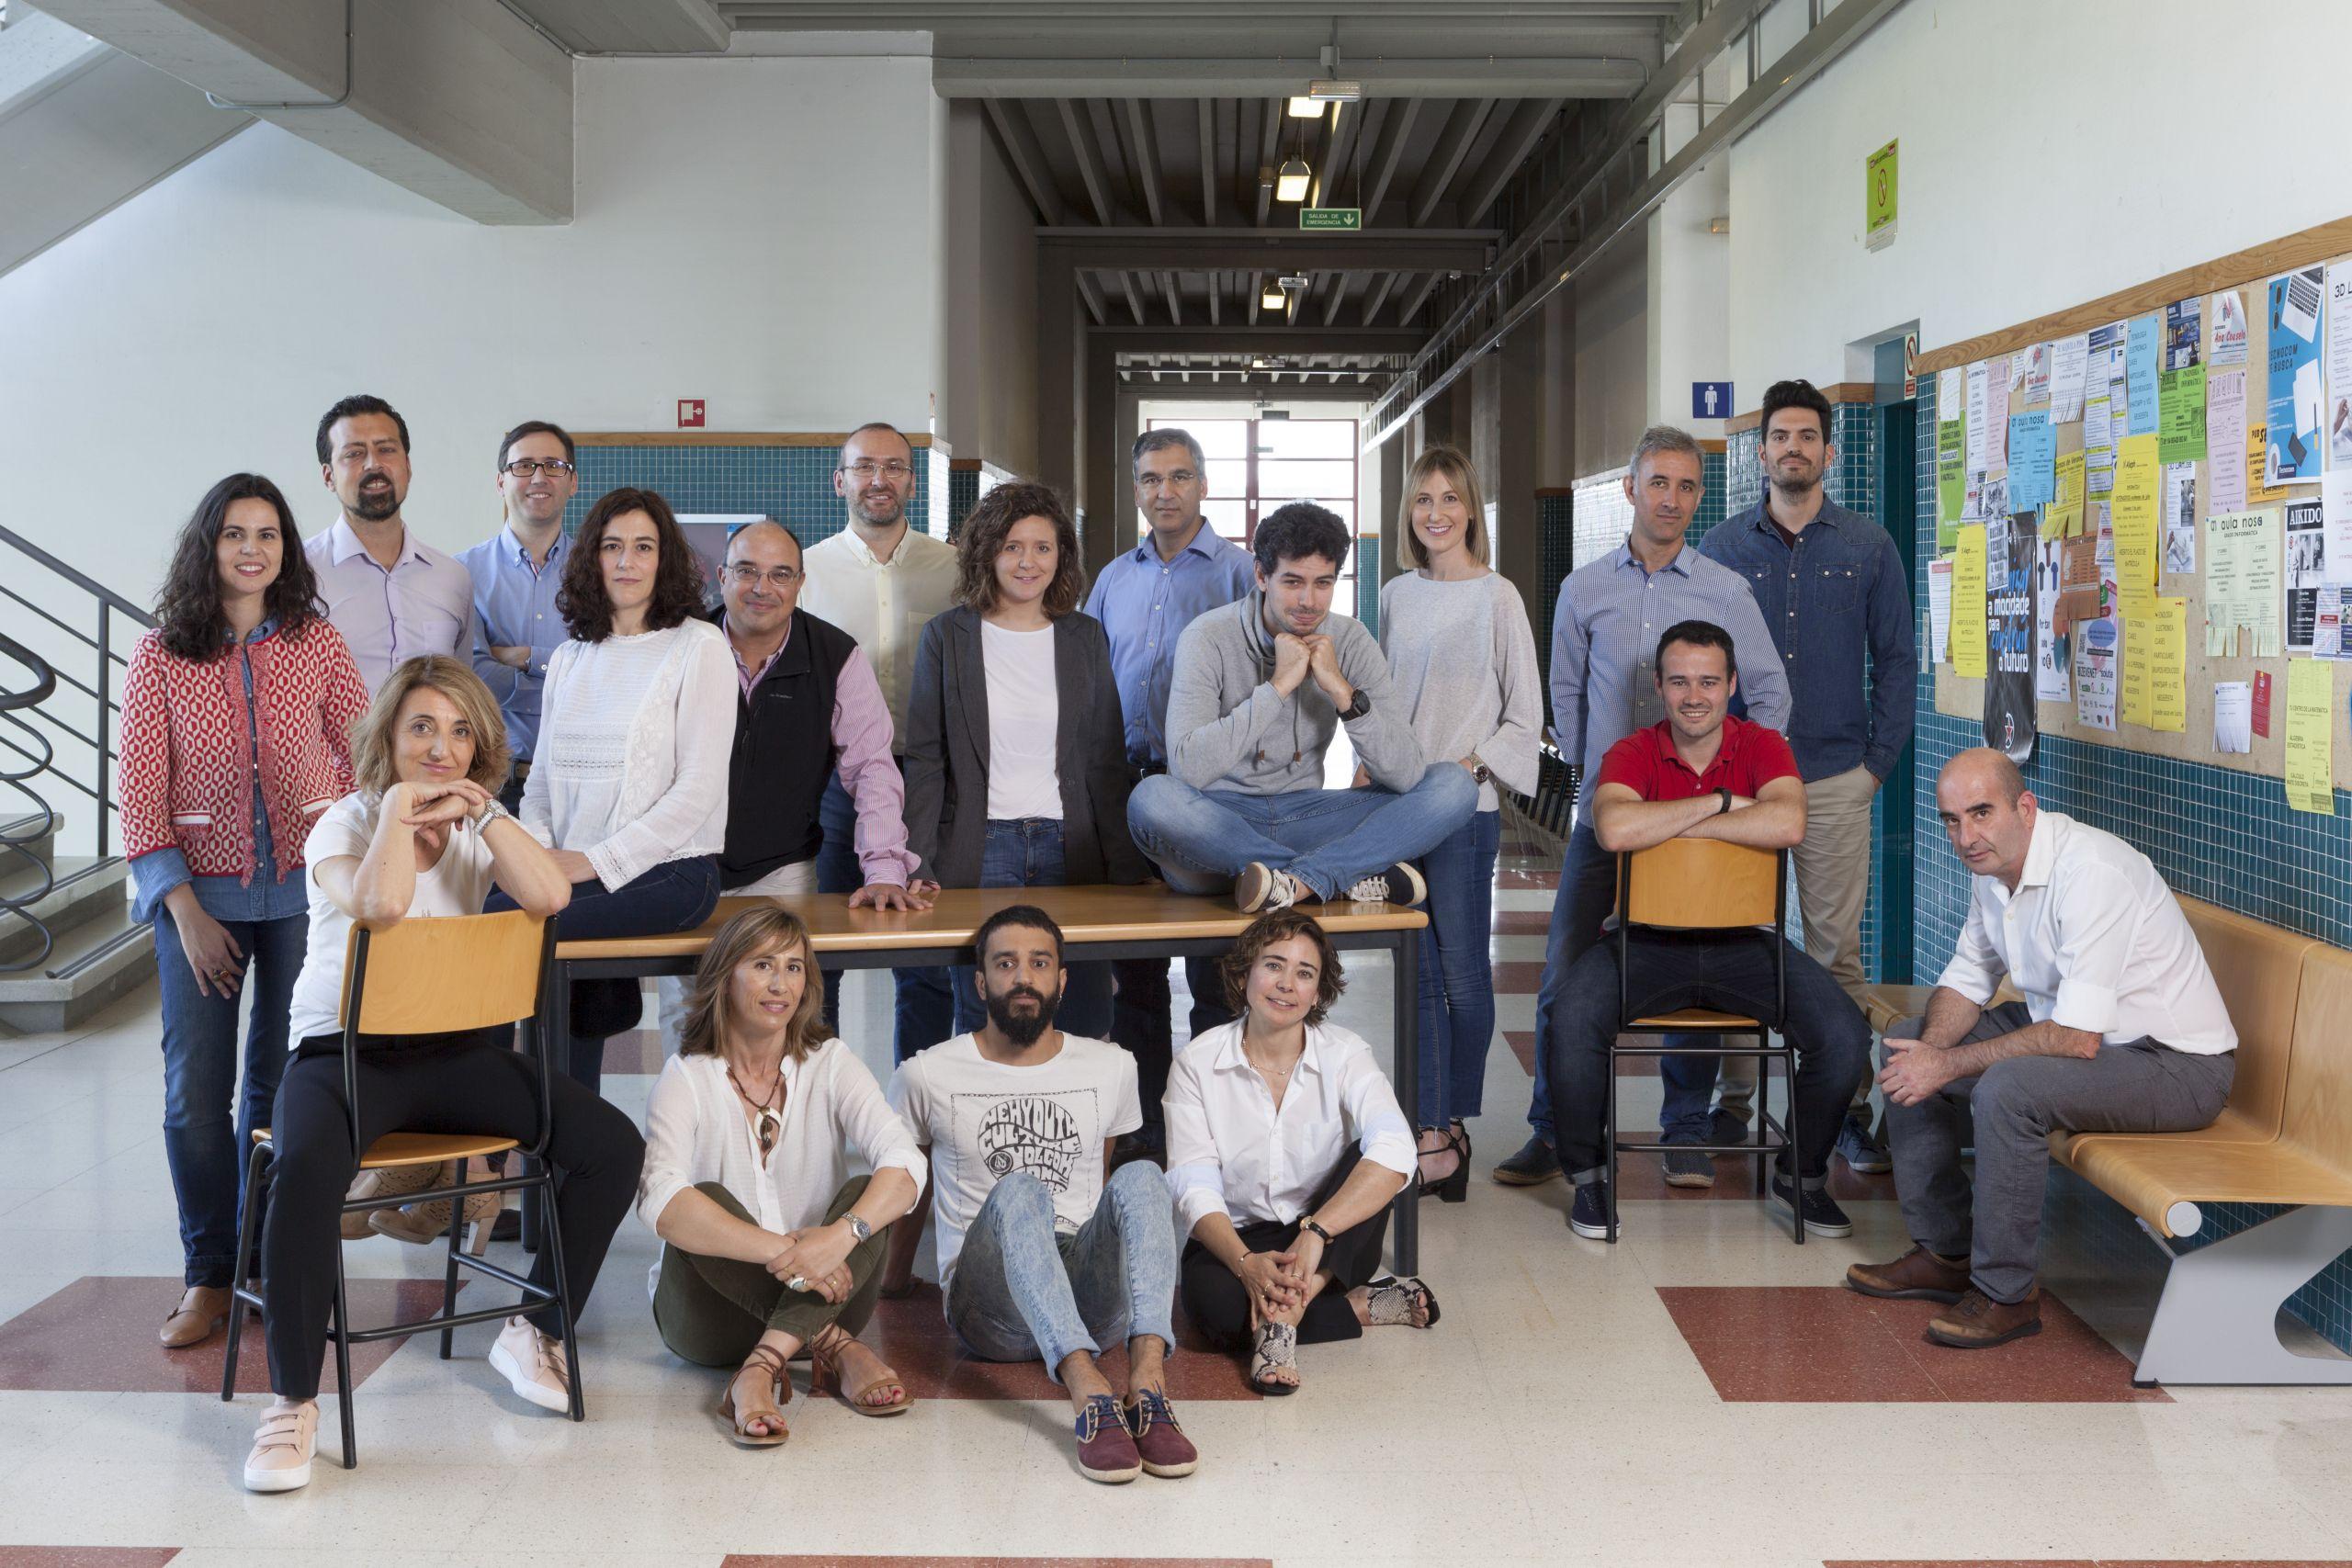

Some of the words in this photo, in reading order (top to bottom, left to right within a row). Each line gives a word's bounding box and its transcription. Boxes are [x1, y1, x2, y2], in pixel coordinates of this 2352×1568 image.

[2221, 515, 2238, 529] aula
[2290, 507, 2323, 525] AIKIDO
[1987, 600, 1992, 615] a
[1994, 592, 2030, 615] mocidade
[1988, 618, 2000, 635] para
[1998, 658, 2003, 671] o
[2004, 647, 2029, 672] futuro
[984, 1100, 1022, 1131] NEW
[1020, 1098, 1079, 1142] YOUTH
[979, 1124, 1082, 1155] CULTURE
[1012, 1144, 1075, 1180] VOLCOM
